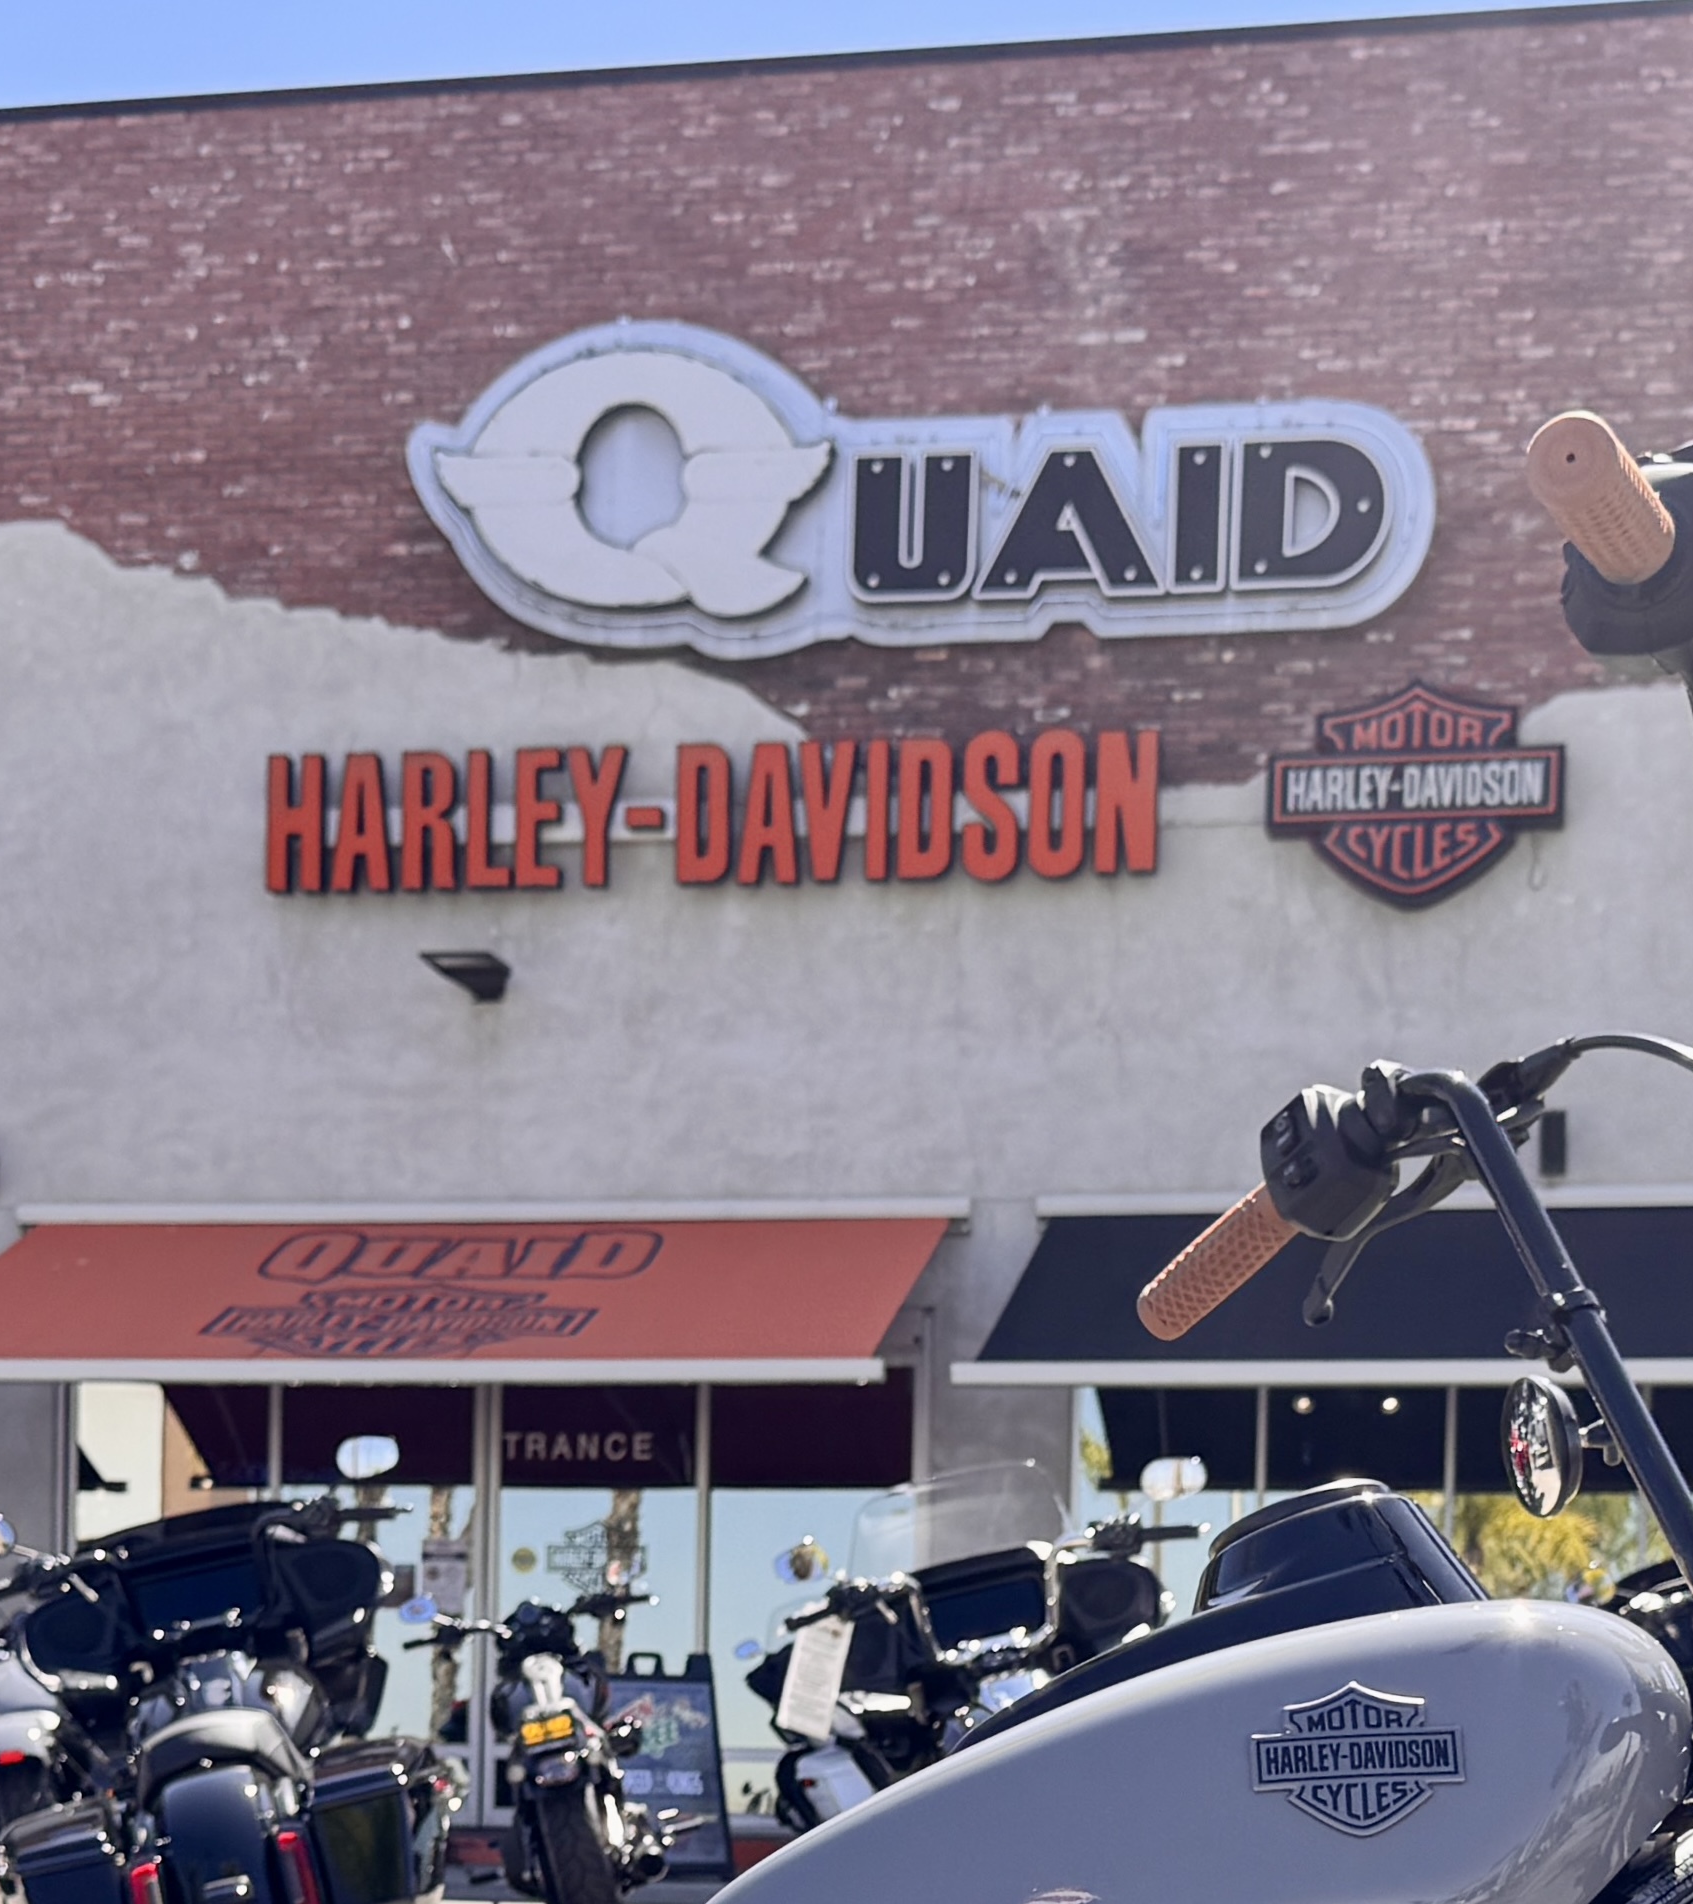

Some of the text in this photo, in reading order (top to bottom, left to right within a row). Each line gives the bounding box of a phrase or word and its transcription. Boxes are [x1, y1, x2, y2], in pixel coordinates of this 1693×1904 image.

[432, 348, 1390, 618] QUAID
[1351, 711, 1485, 749] MOTOR
[1286, 757, 1544, 813] HARLEY-DAVIDSON
[264, 728, 1160, 892] HARLEY-DAVIDSON
[1345, 823, 1482, 866] CYCLES
[258, 1231, 663, 1284] QUAID
[504, 1432, 654, 1461] TRANCE
[1307, 1698, 1403, 1733] MOTOR
[1265, 1737, 1450, 1777] HARLEY-DAVIDSON
[1311, 1780, 1407, 1821] CYCLES
